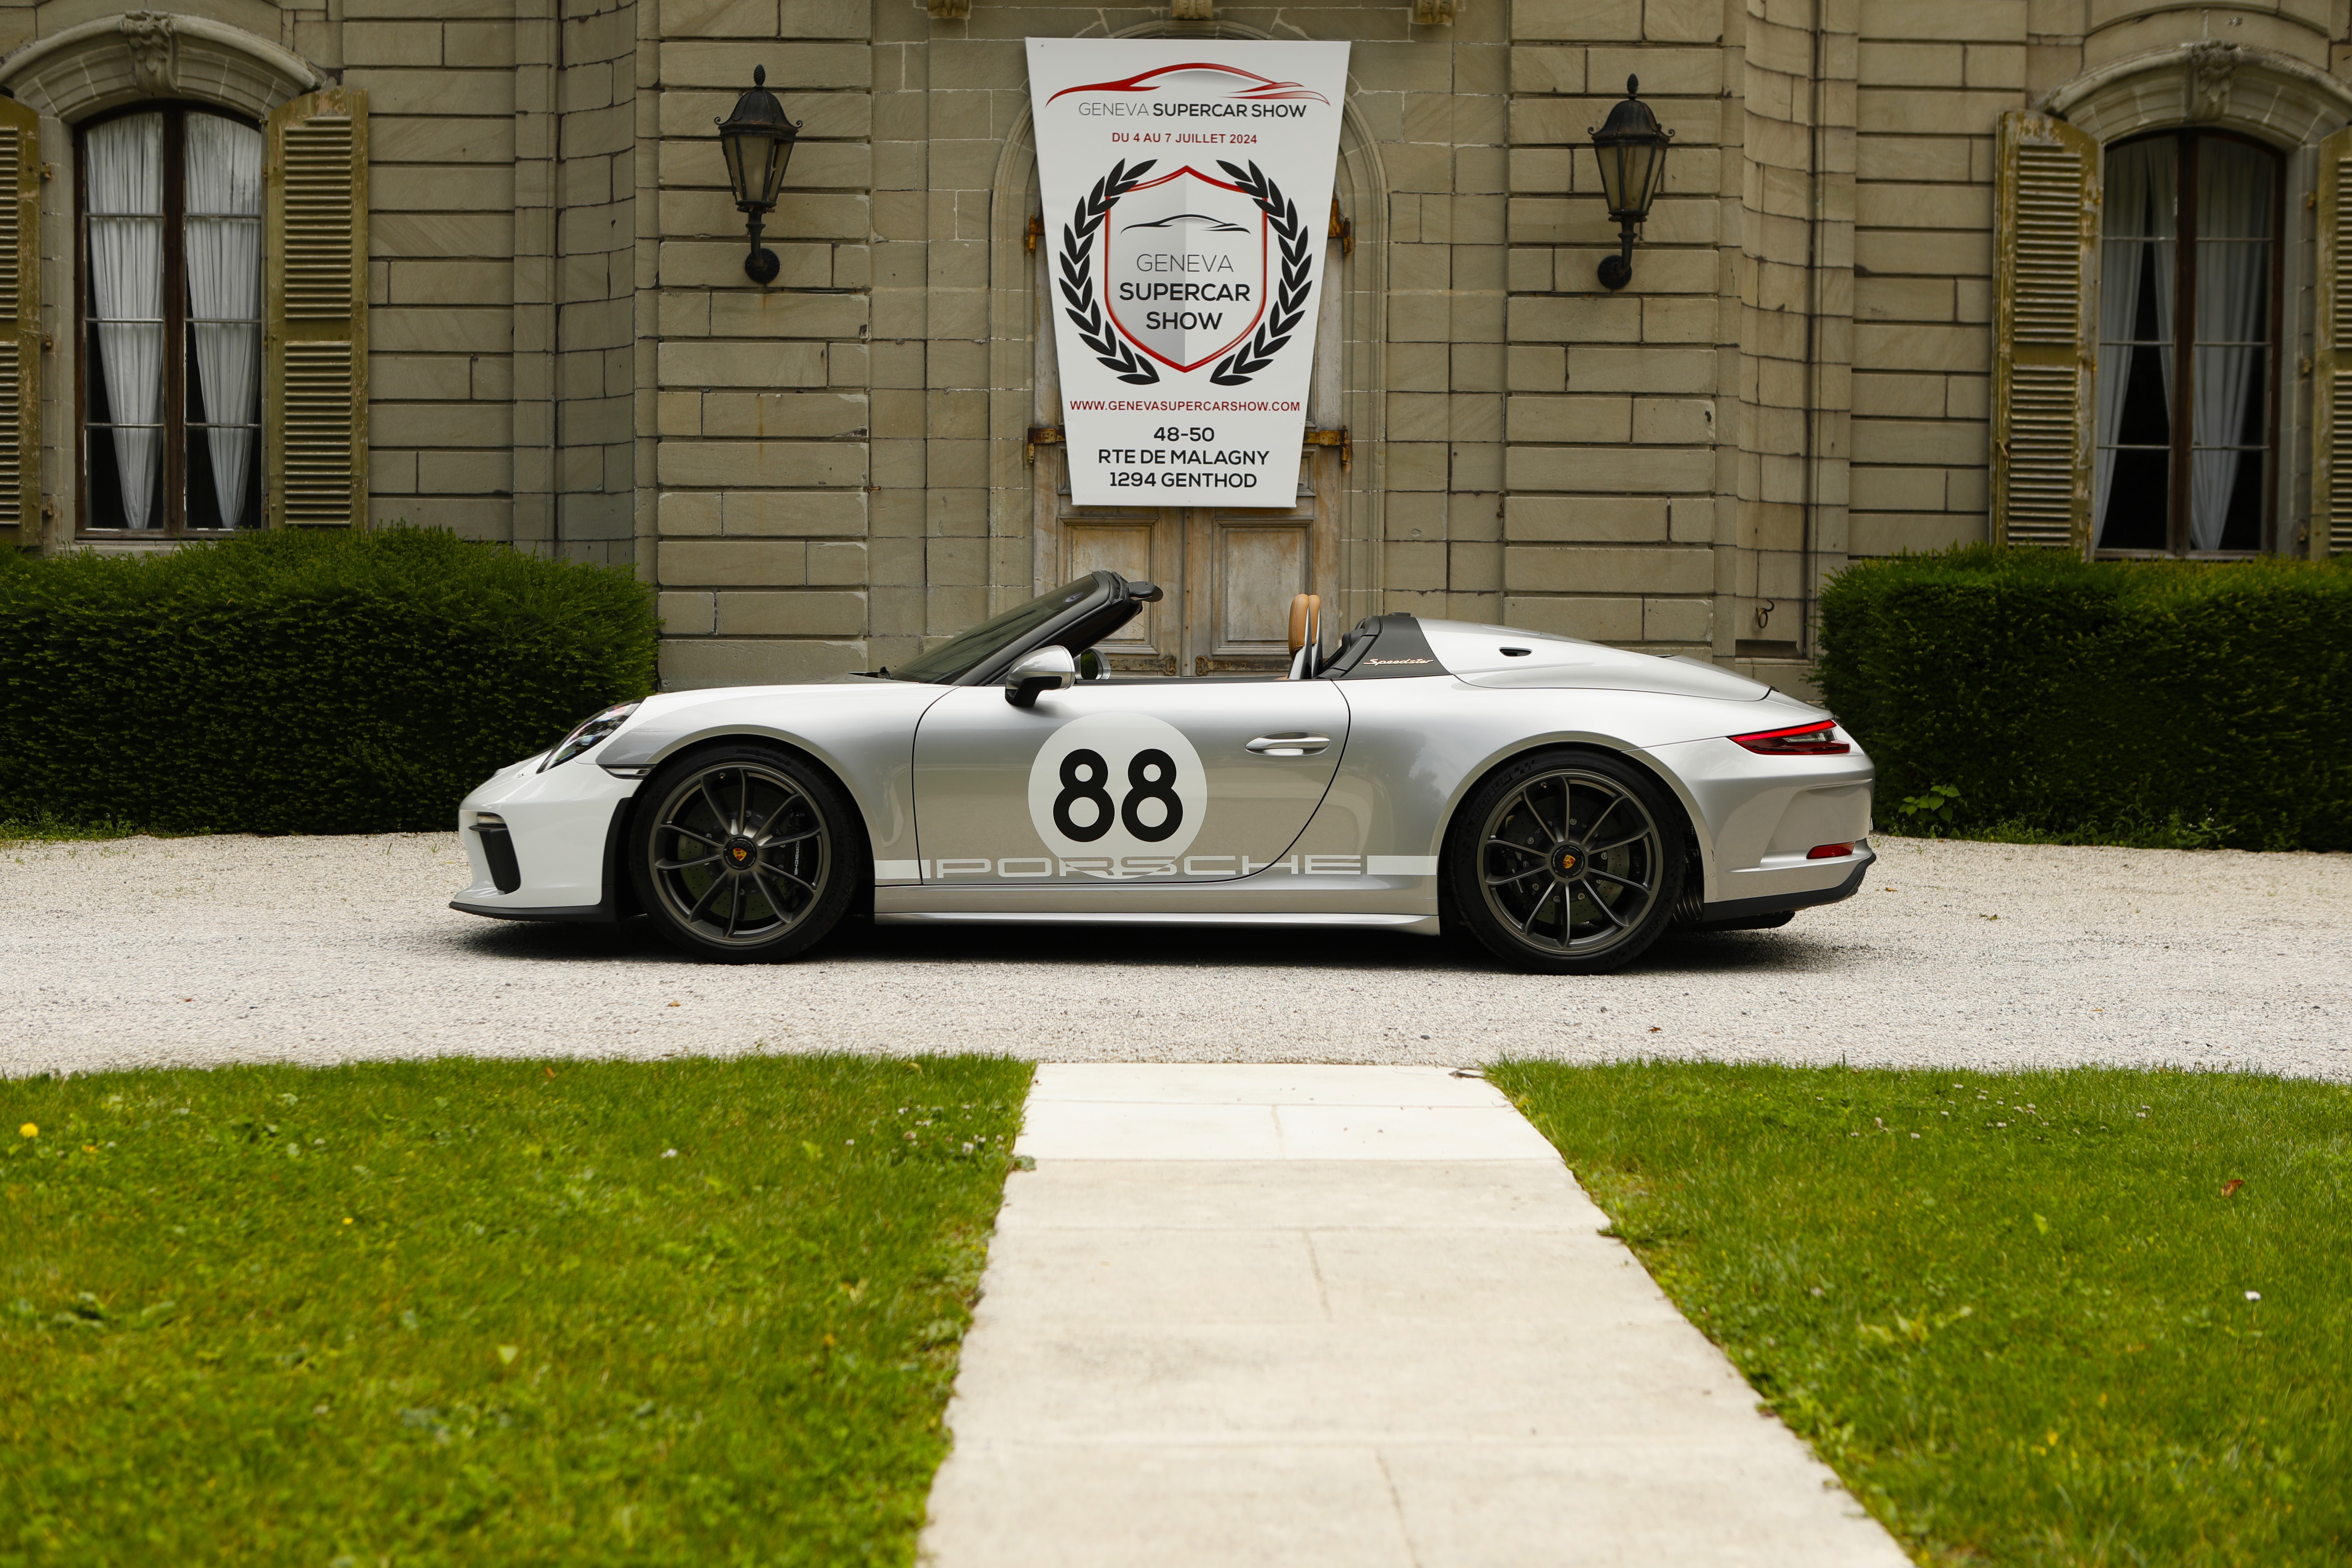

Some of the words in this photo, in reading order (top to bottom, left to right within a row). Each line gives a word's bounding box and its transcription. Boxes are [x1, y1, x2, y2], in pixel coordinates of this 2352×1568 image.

[1079, 102, 1149, 116] GENEVA
[1153, 103, 1247, 117] SUPERCAR
[1252, 104, 1306, 118] SHOW
[1112, 132, 1130, 143] DU
[1133, 133, 1140, 143] 4
[1143, 133, 1160, 143] AU
[1165, 133, 1171, 143] 7
[1175, 133, 1225, 144] JUILLET
[1230, 134, 1257, 144] 2024
[1137, 253, 1234, 272] GENEVA
[1119, 282, 1250, 302] SUPERCAR
[1146, 312, 1223, 330] SHOW
[1070, 400, 1300, 412] WWW.GENEVASUPERCARSHOW.COM
[1154, 427, 1215, 442] 48-50
[1099, 449, 1136, 464] RTE
[1141, 450, 1166, 464] DE
[1171, 450, 1270, 465] MALAGNY
[1110, 472, 1156, 487] 1294
[1161, 472, 1257, 488] GENTHOD
[1053, 748, 1183, 842] 88
[1470, 773, 1511, 822] MICHELIN
[936, 855, 1361, 879] PORSCHE
